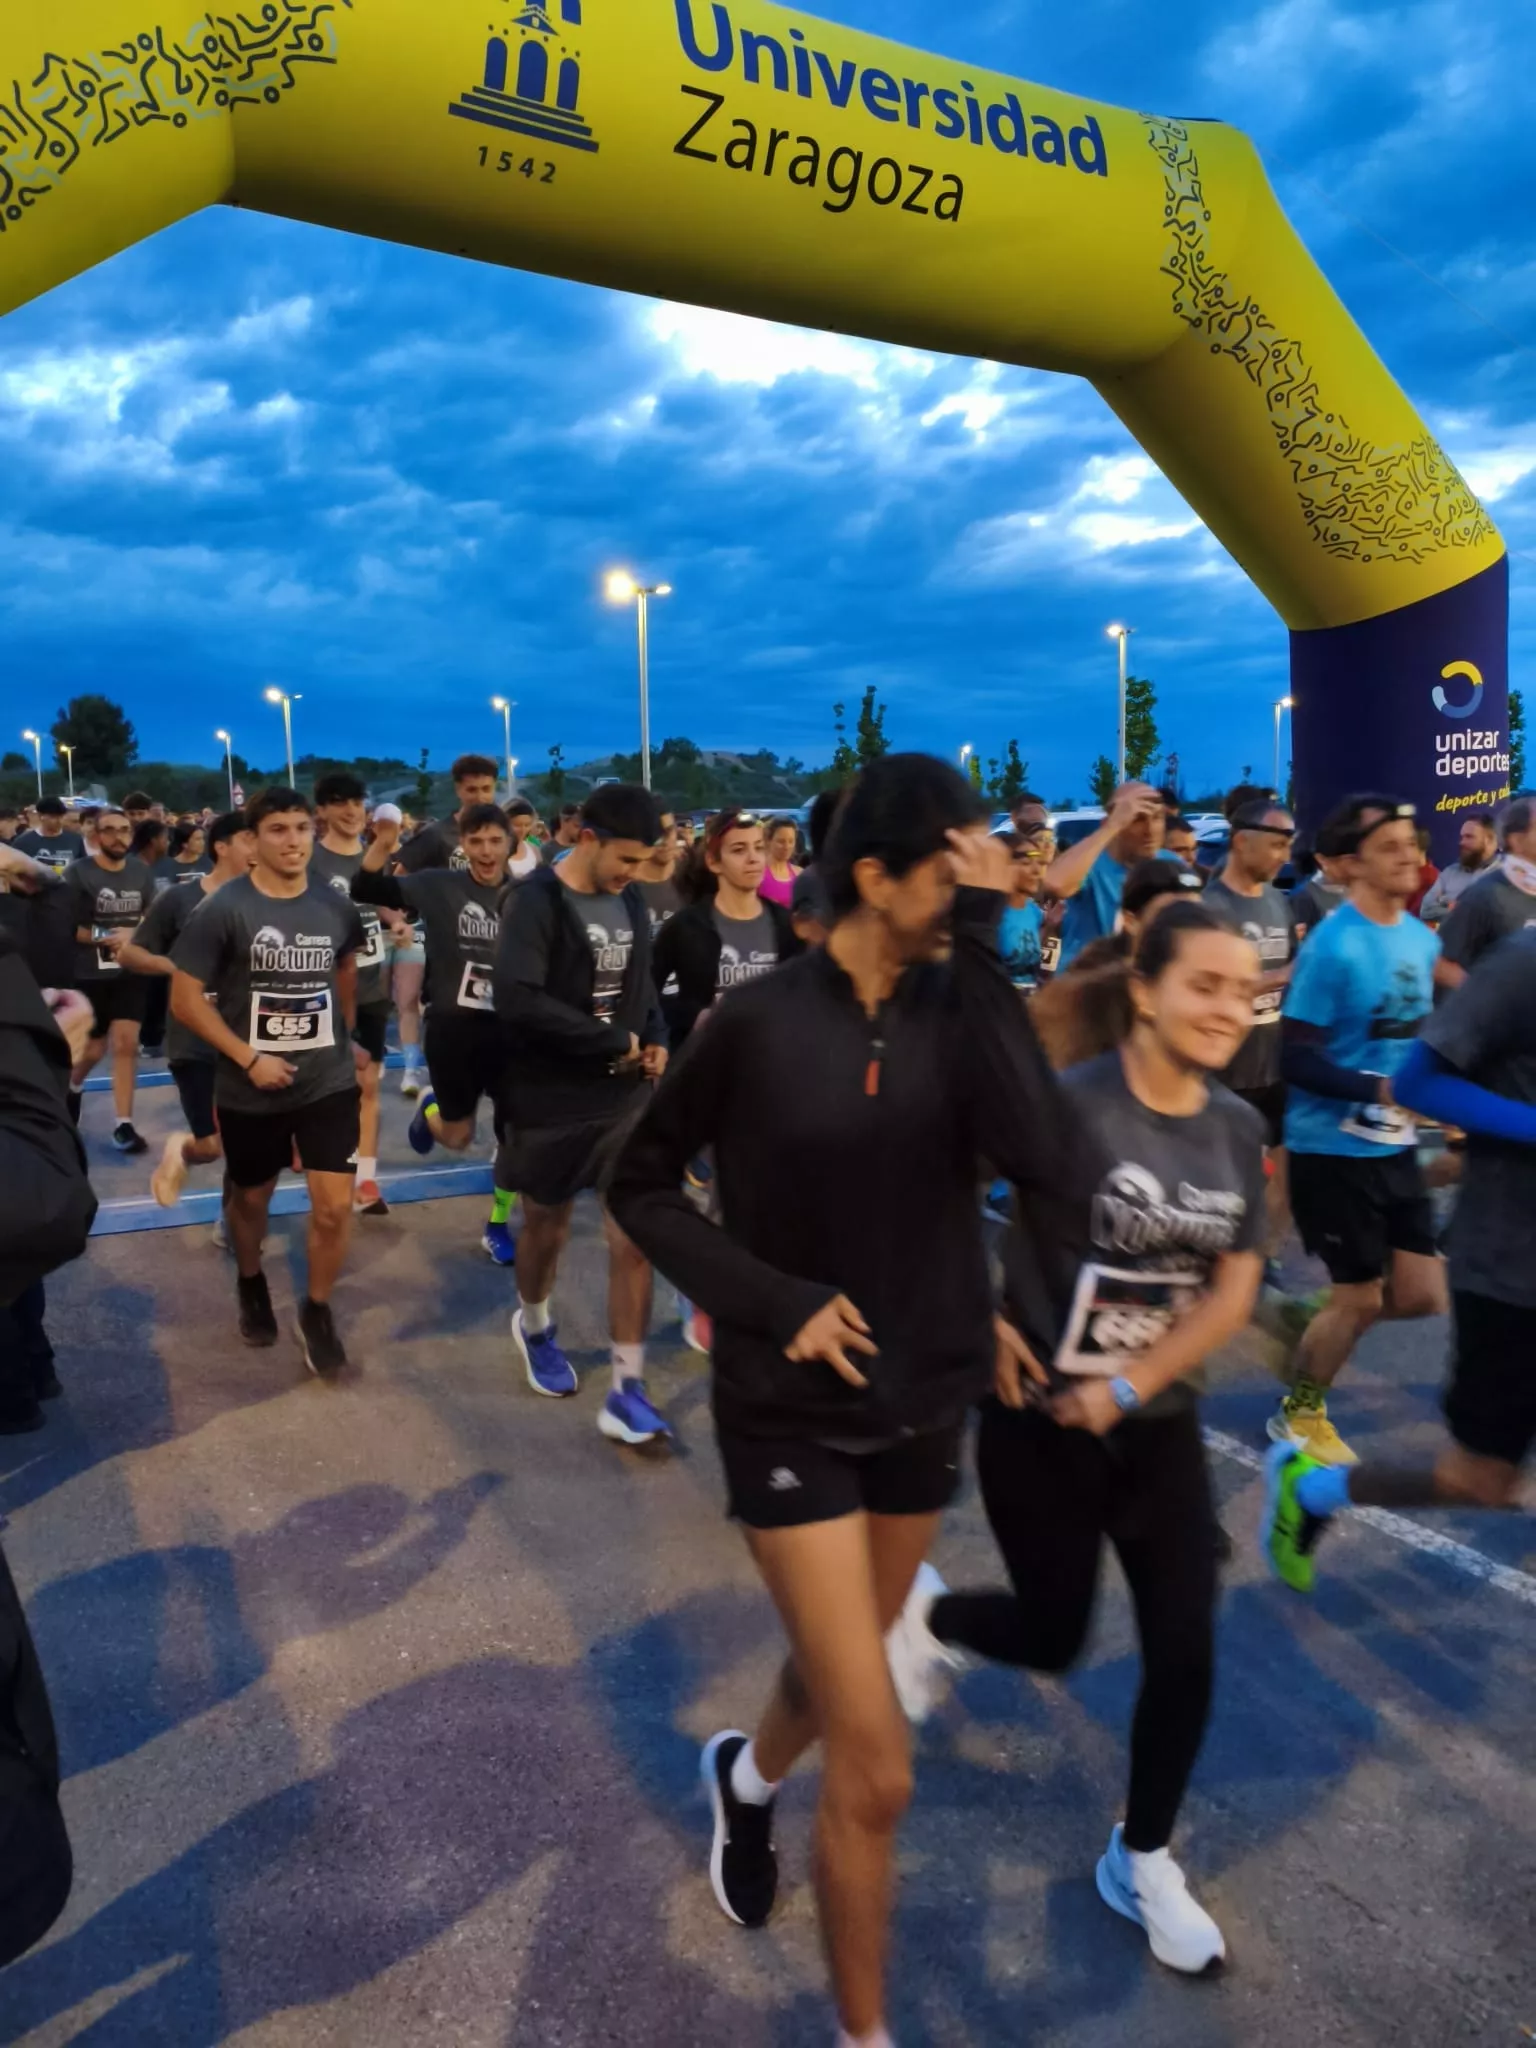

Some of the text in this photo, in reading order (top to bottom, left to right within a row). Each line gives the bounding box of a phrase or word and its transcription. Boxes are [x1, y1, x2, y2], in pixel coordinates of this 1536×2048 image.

[674, 0, 1109, 177] Universidad
[475, 144, 558, 185] 1542
[673, 83, 966, 223] Zaragoza
[1435, 728, 1500, 752] unizar
[1435, 789, 1489, 814] deporte
[250, 944, 335, 972] Nocturna
[266, 1016, 312, 1036] 655
